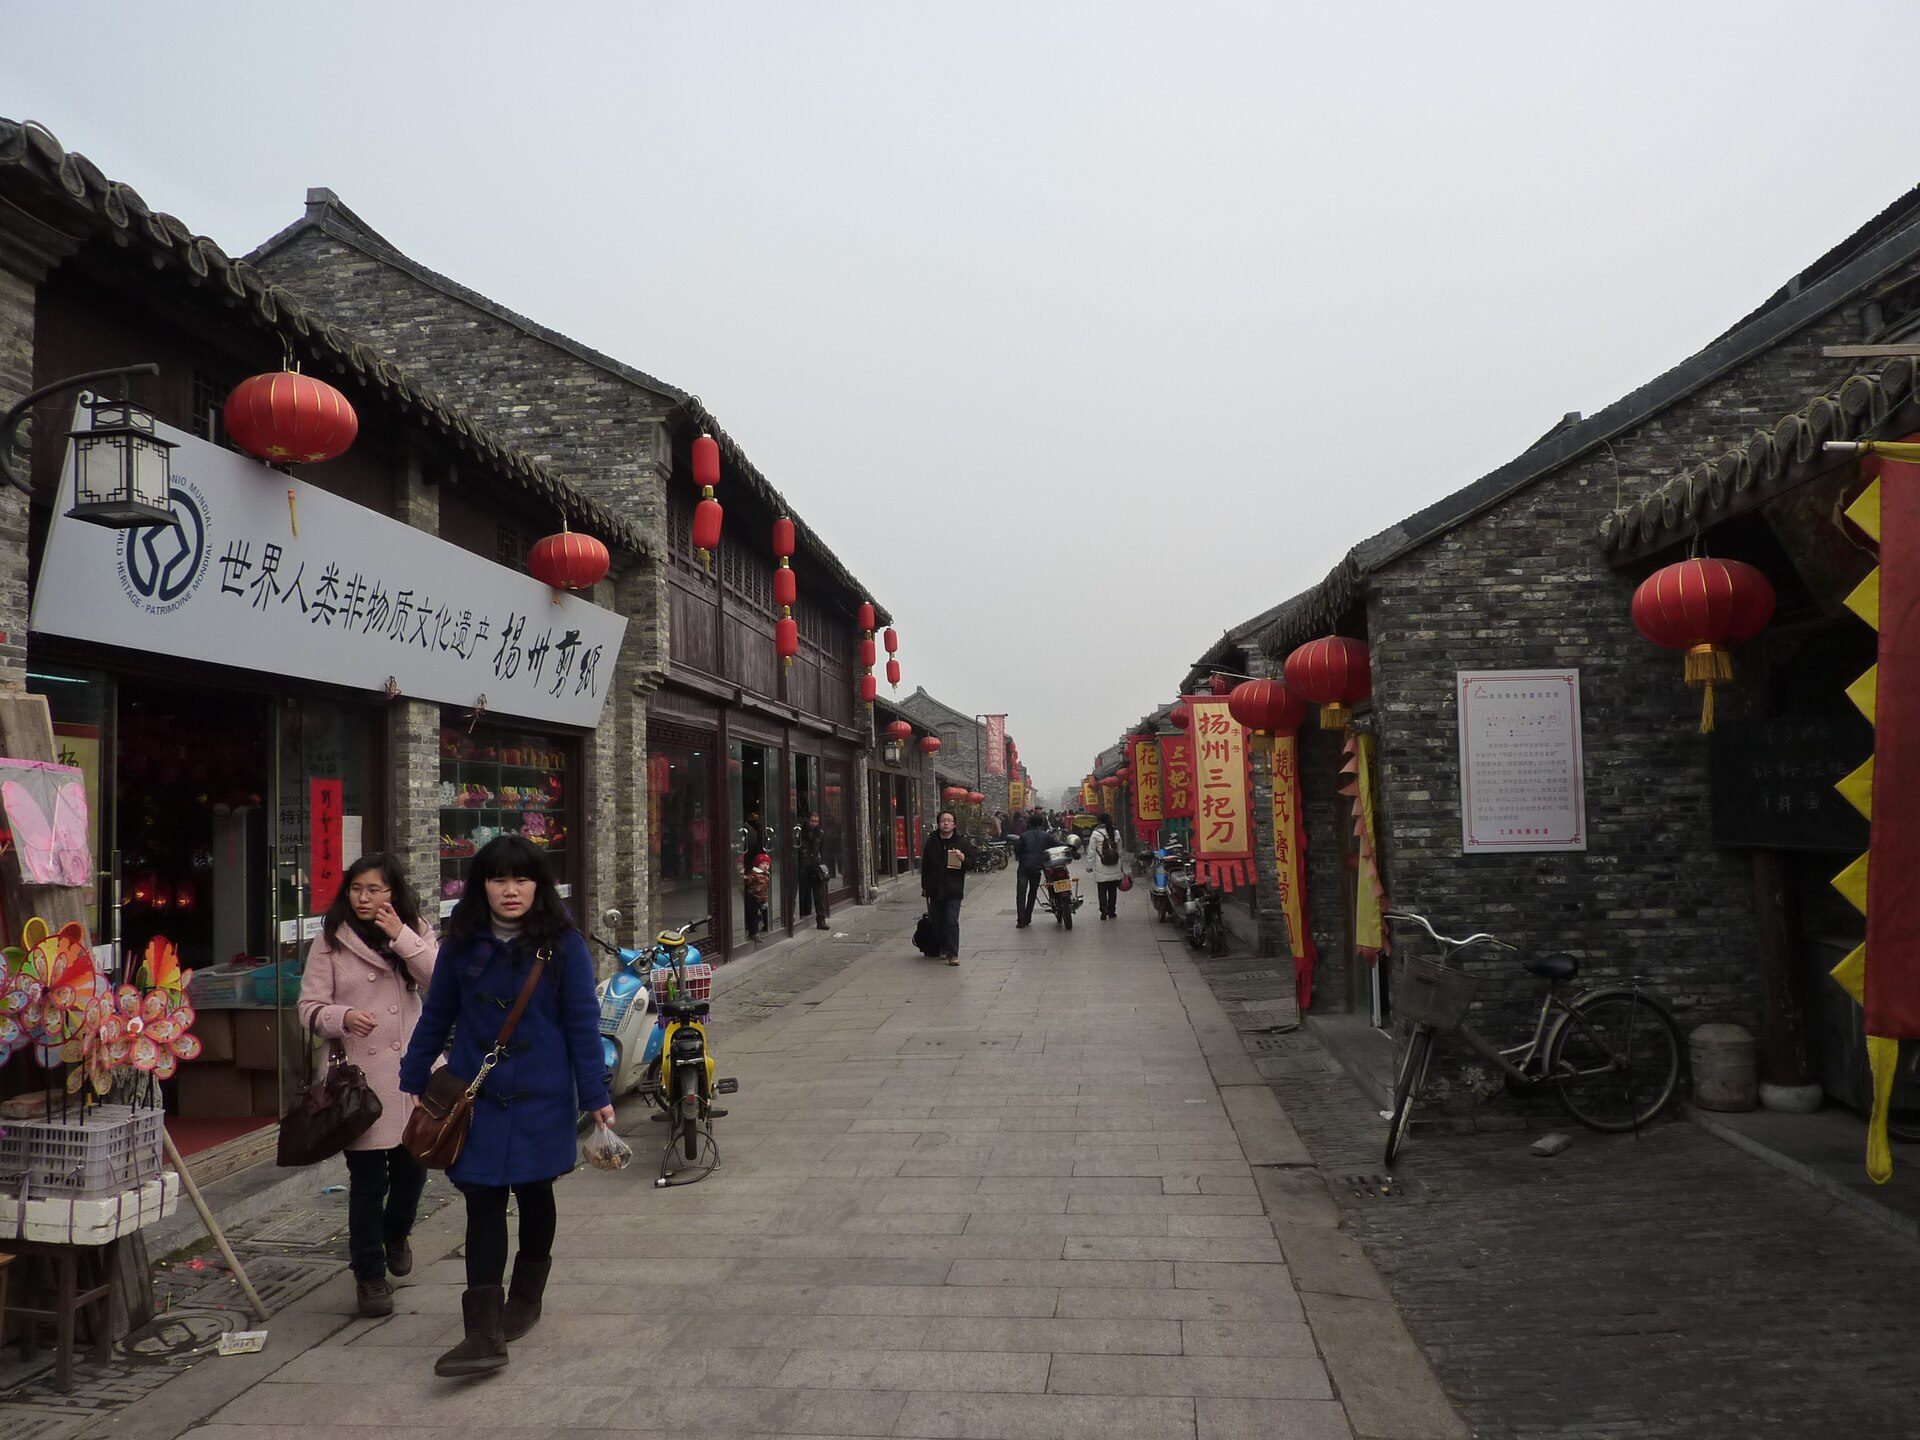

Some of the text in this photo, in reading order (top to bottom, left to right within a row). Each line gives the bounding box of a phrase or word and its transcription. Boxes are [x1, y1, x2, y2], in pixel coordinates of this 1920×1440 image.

[188, 483, 213, 529] MUNDIAL
[117, 561, 142, 608] HERITAGE
[145, 542, 213, 616] PATRIMOINE MONDIAL
[219, 539, 491, 662] 世界人类非物质文化遗产
[1168, 745, 1190, 809] 三把刀
[1198, 711, 1236, 844] 扬州三把刀
